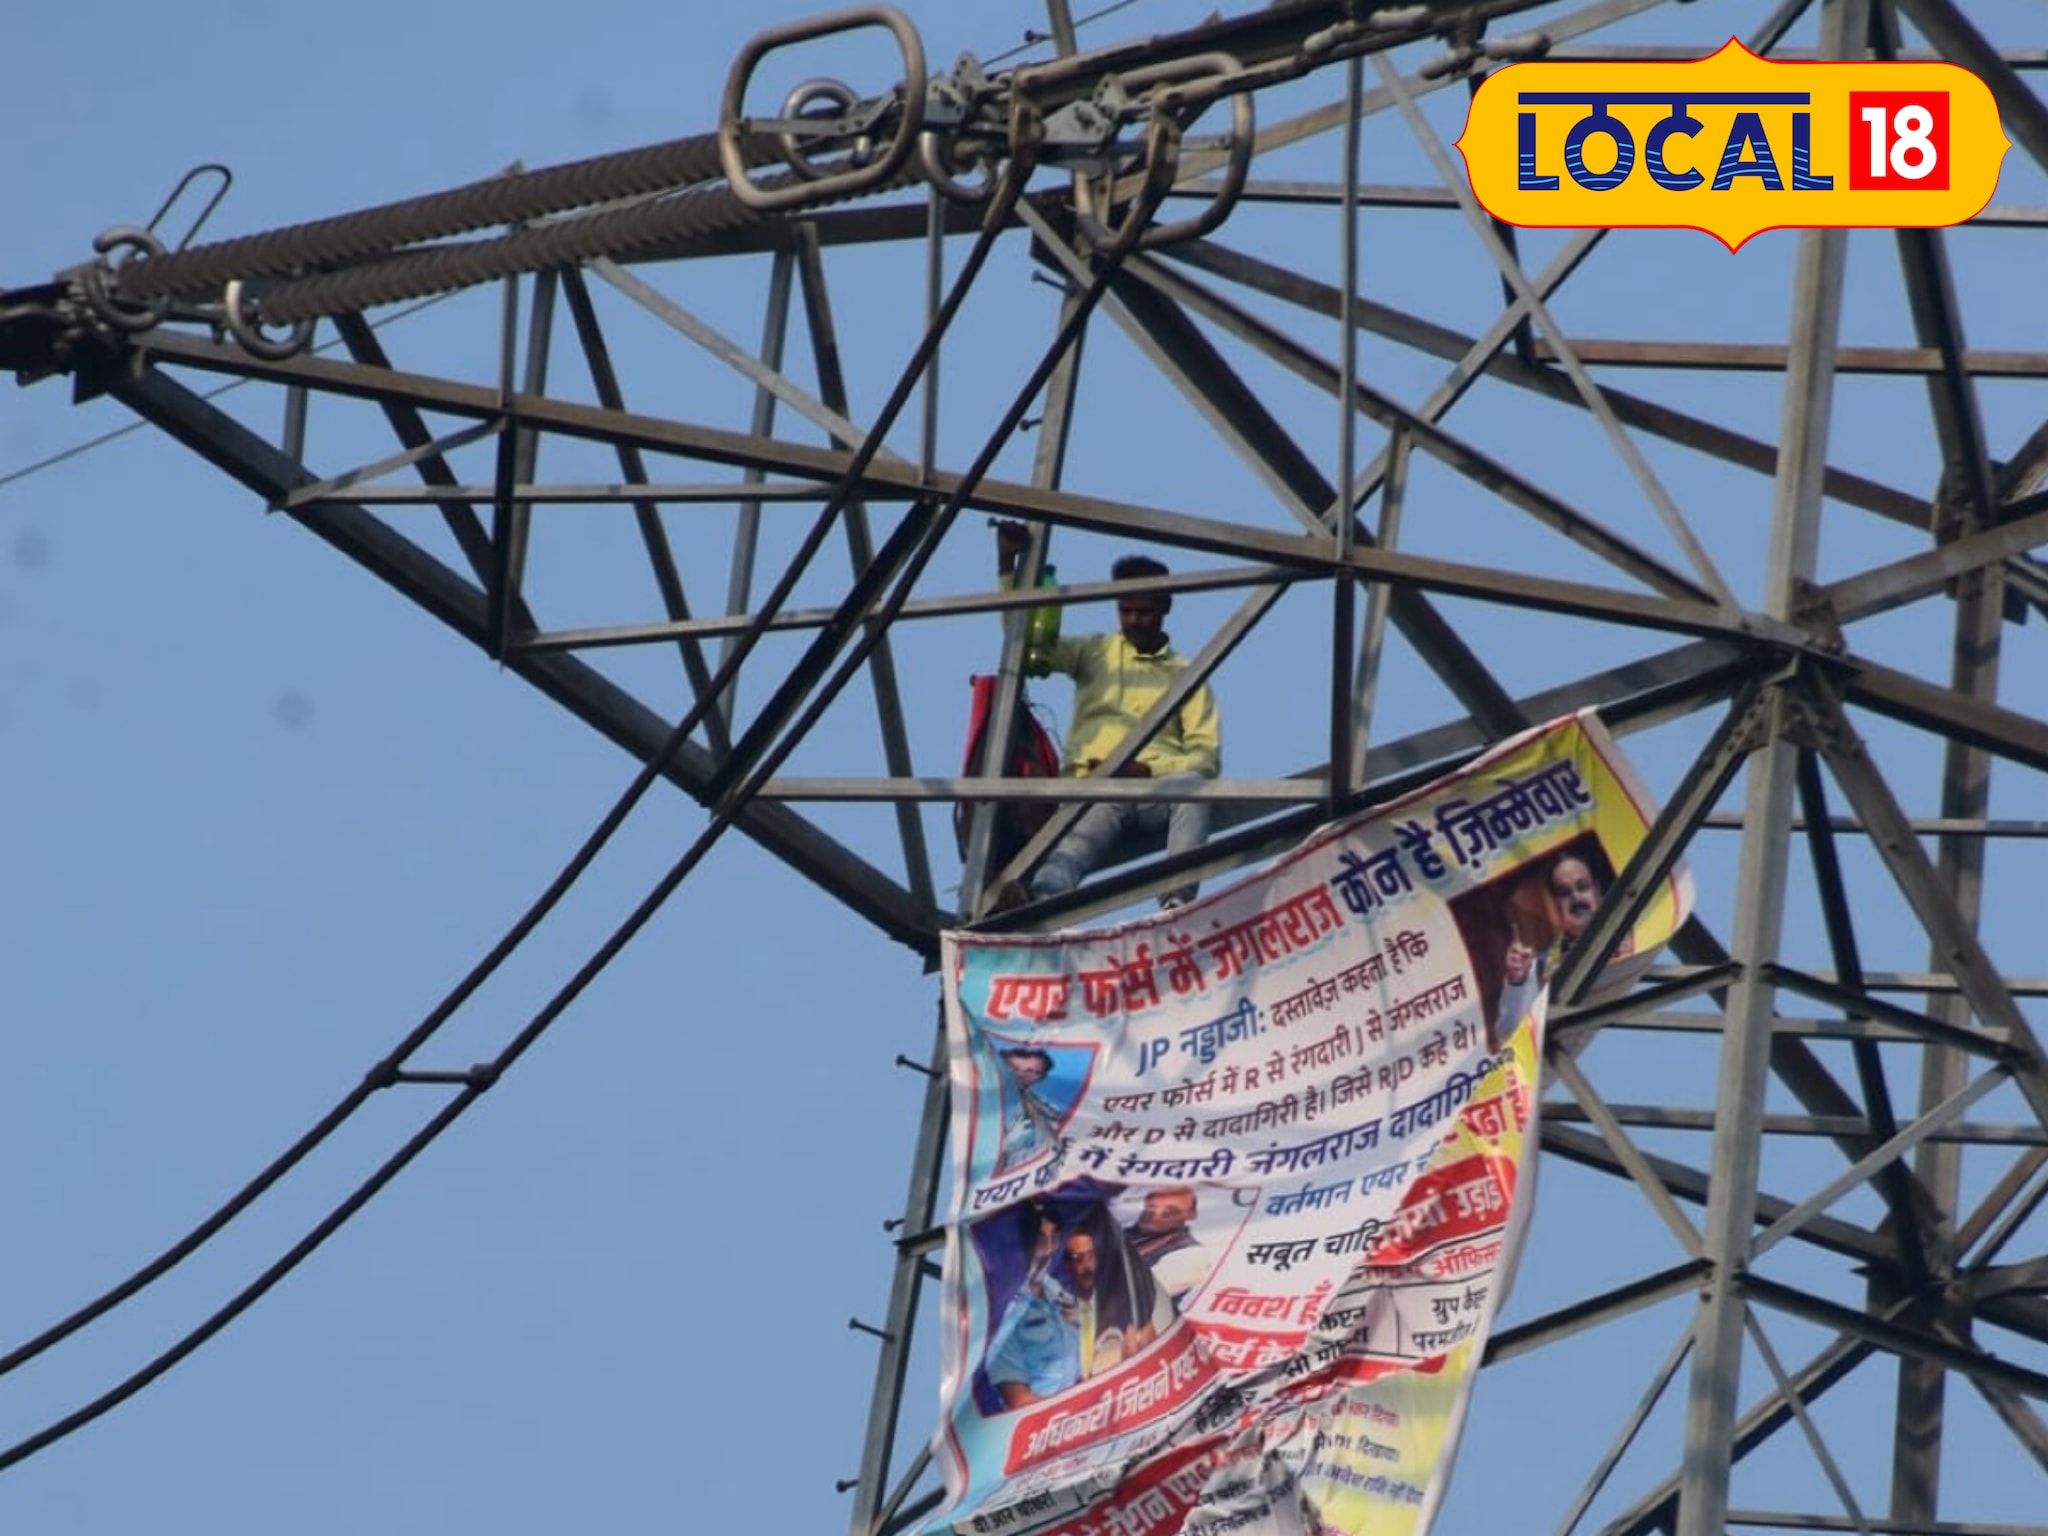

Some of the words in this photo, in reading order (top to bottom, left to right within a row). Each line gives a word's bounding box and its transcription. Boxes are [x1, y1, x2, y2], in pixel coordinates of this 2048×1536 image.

[985, 975, 1072, 1023] एयर
[1077, 943, 1161, 1019] फोर्स
[1158, 930, 1207, 993] में
[1198, 882, 1345, 982] जंगलराज
[1330, 848, 1414, 916] कौन
[1394, 819, 1447, 881] है
[1103, 1092, 1154, 1113] एयर
[1161, 1071, 1217, 1107] फोर्स
[1221, 1066, 1240, 1095] में
[1245, 1069, 1260, 1090] R
[1265, 1050, 1286, 1083] से
[1289, 1023, 1352, 1076] रंगदारी
[1367, 1008, 1385, 1042] से
[1387, 973, 1468, 1033] जंगलराज
[1136, 1037, 1171, 1077] JP
[1337, 952, 1389, 996] कहता
[1143, 1127, 1166, 1145] D
[1173, 1115, 1198, 1143] से
[1202, 1091, 1299, 1140] दादागिरी
[1331, 1066, 1373, 1108] जिसे
[1379, 1056, 1414, 1093] RJD
[1419, 1031, 1448, 1069] कहे
[1118, 1148, 1234, 1179] रंगदारी
[1246, 1117, 1384, 1176] जंगलराज
[1361, 1160, 1412, 1196] एयर
[1246, 1236, 1319, 1272] सबूत
